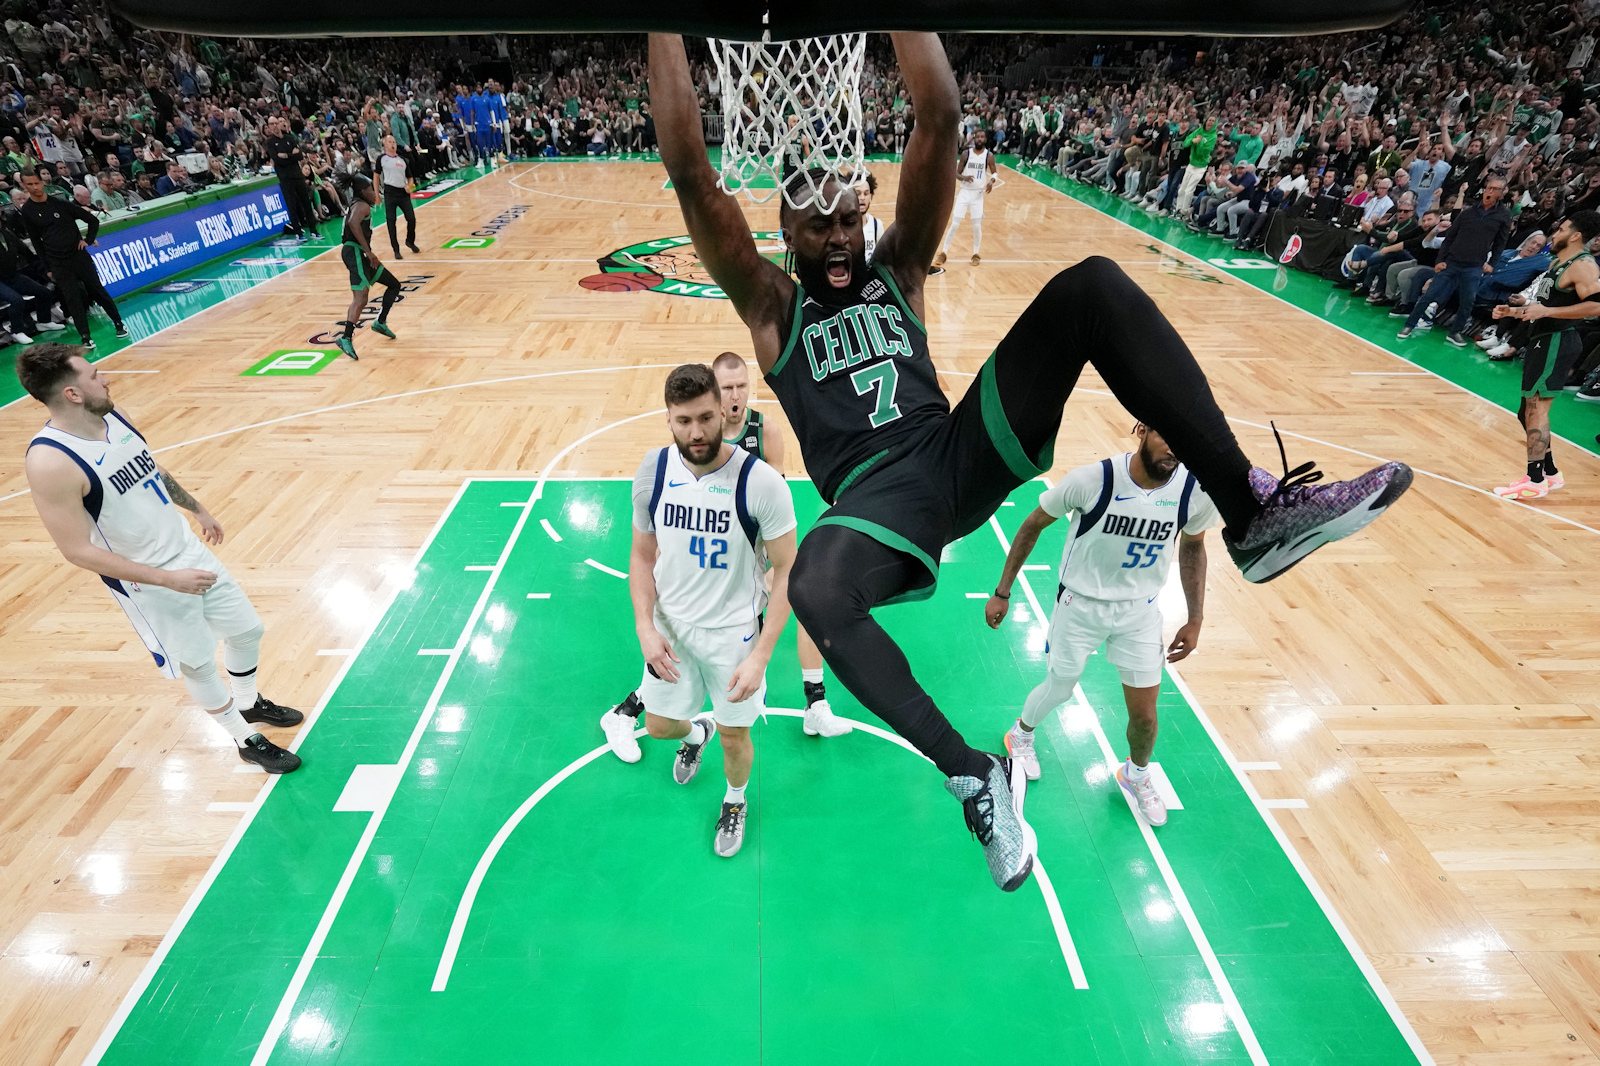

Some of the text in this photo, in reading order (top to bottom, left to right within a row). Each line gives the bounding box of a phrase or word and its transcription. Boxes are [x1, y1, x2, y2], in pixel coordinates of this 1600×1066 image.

[976, 169, 983, 179] 11
[196, 212, 232, 248] BEGINS
[228, 205, 254, 237] JUNE
[247, 202, 263, 230] 26
[470, 204, 534, 237] GARDEN
[122, 237, 159, 275] 2024
[860, 278, 884, 299] VISTA
[802, 303, 914, 382] CELTICS
[850, 358, 903, 429] 7
[120, 433, 134, 445] chime
[107, 449, 156, 496] DALLAS
[708, 485, 732, 495] chime
[1155, 499, 1178, 507] chime
[663, 503, 730, 534] DALLAS
[1102, 513, 1174, 541] DALLAS
[689, 536, 728, 569] 42
[1121, 542, 1165, 568] 55
